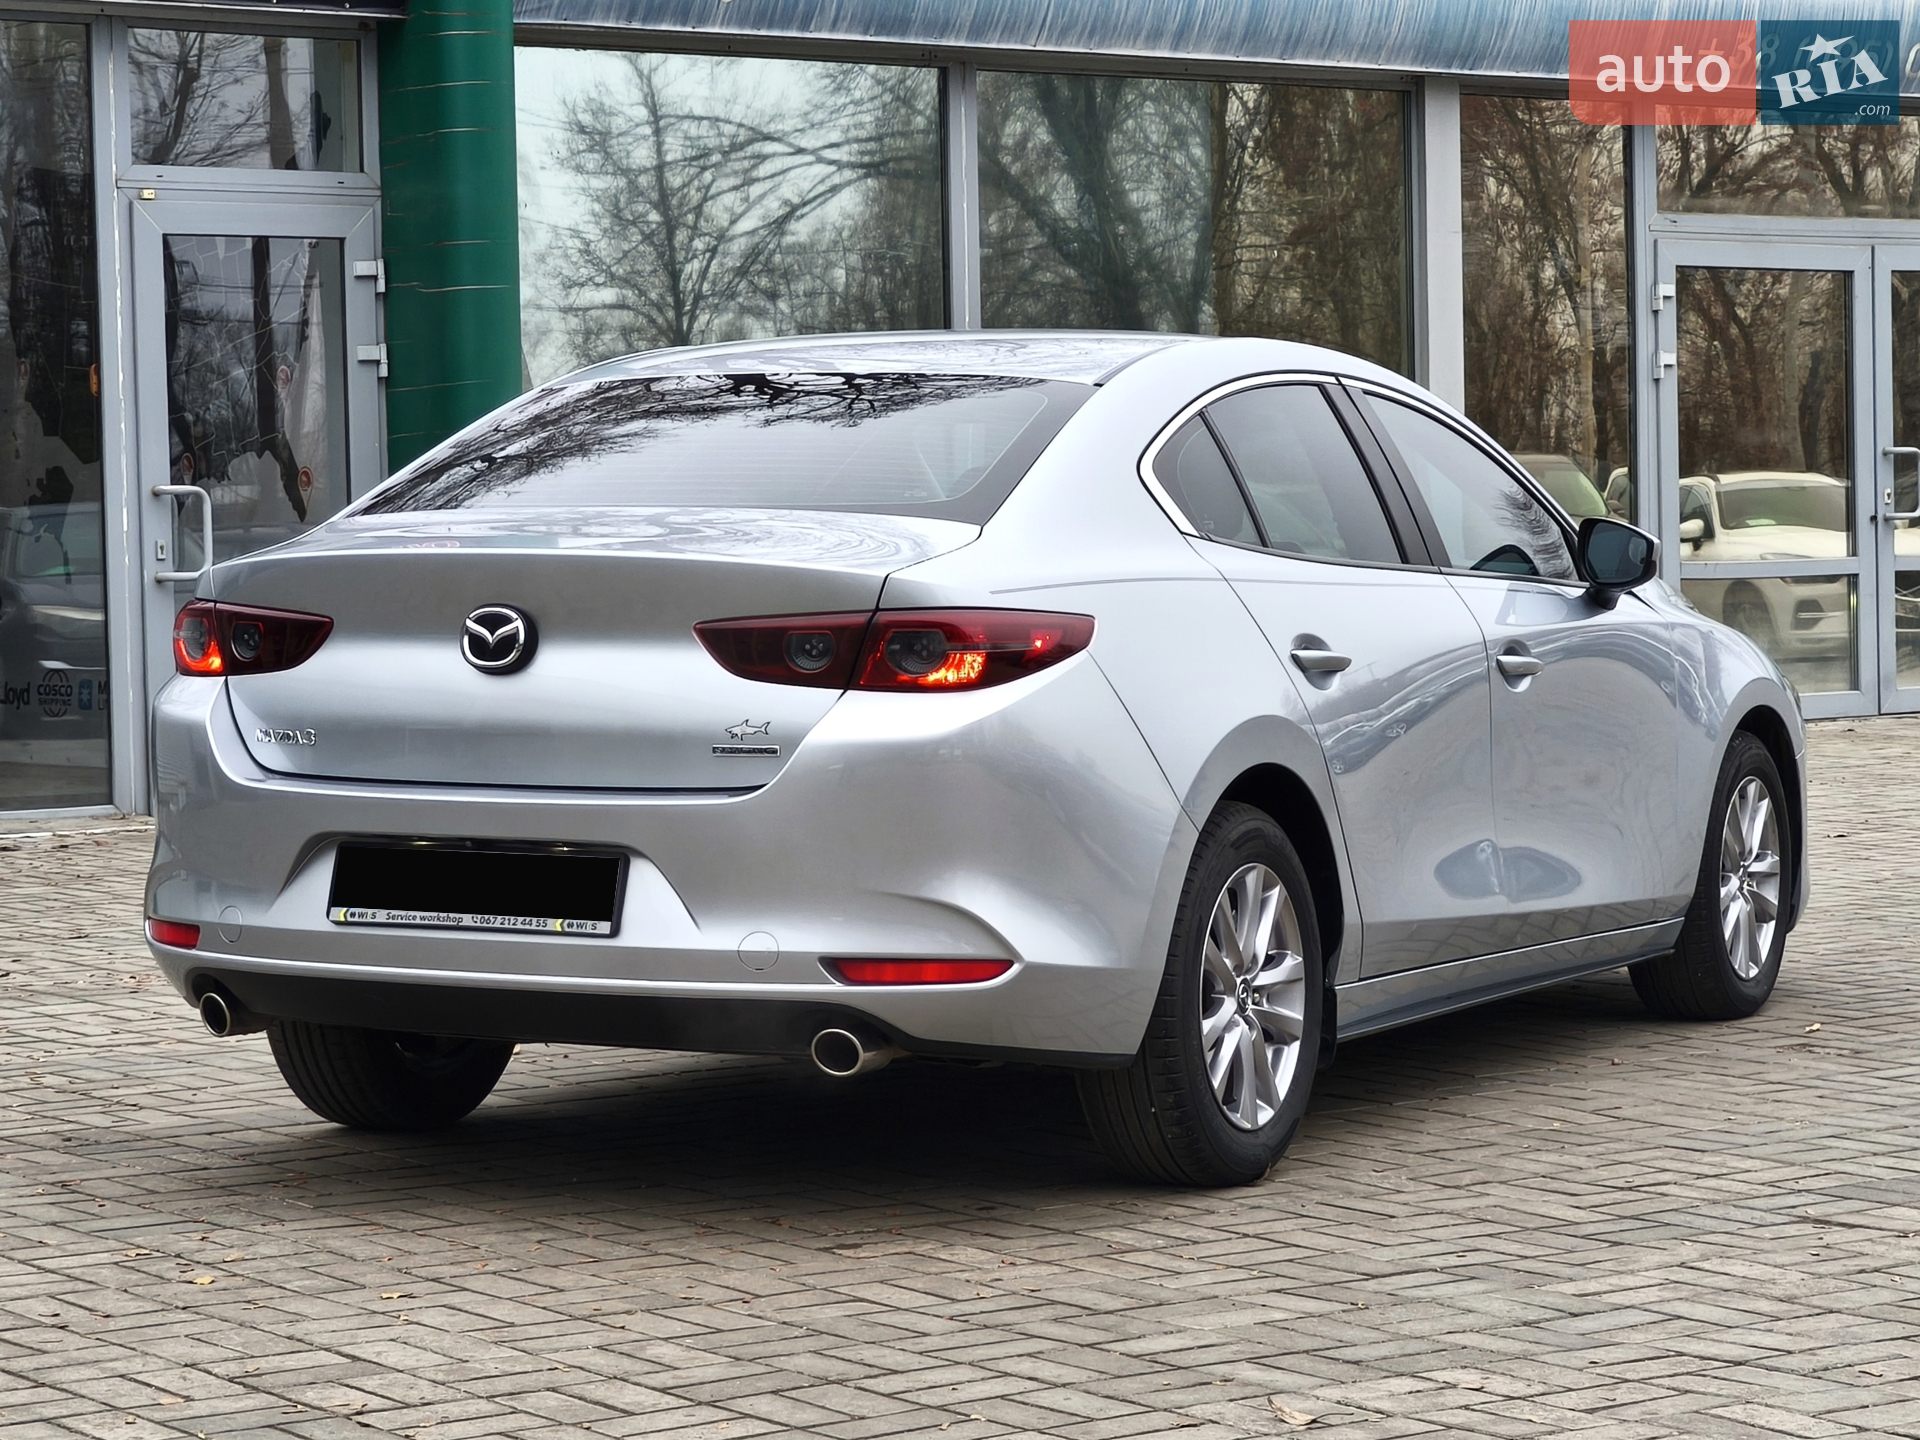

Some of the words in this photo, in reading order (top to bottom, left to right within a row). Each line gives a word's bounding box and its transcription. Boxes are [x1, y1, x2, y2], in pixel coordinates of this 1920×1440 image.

[0, 681, 31, 710] loyd
[37, 683, 73, 697] COSCO
[386, 911, 418, 922] Service
[419, 913, 464, 925] workshop
[480, 916, 498, 925] 067
[500, 917, 519, 926] 212
[520, 918, 533, 928] 44
[535, 919, 548, 928] 55
